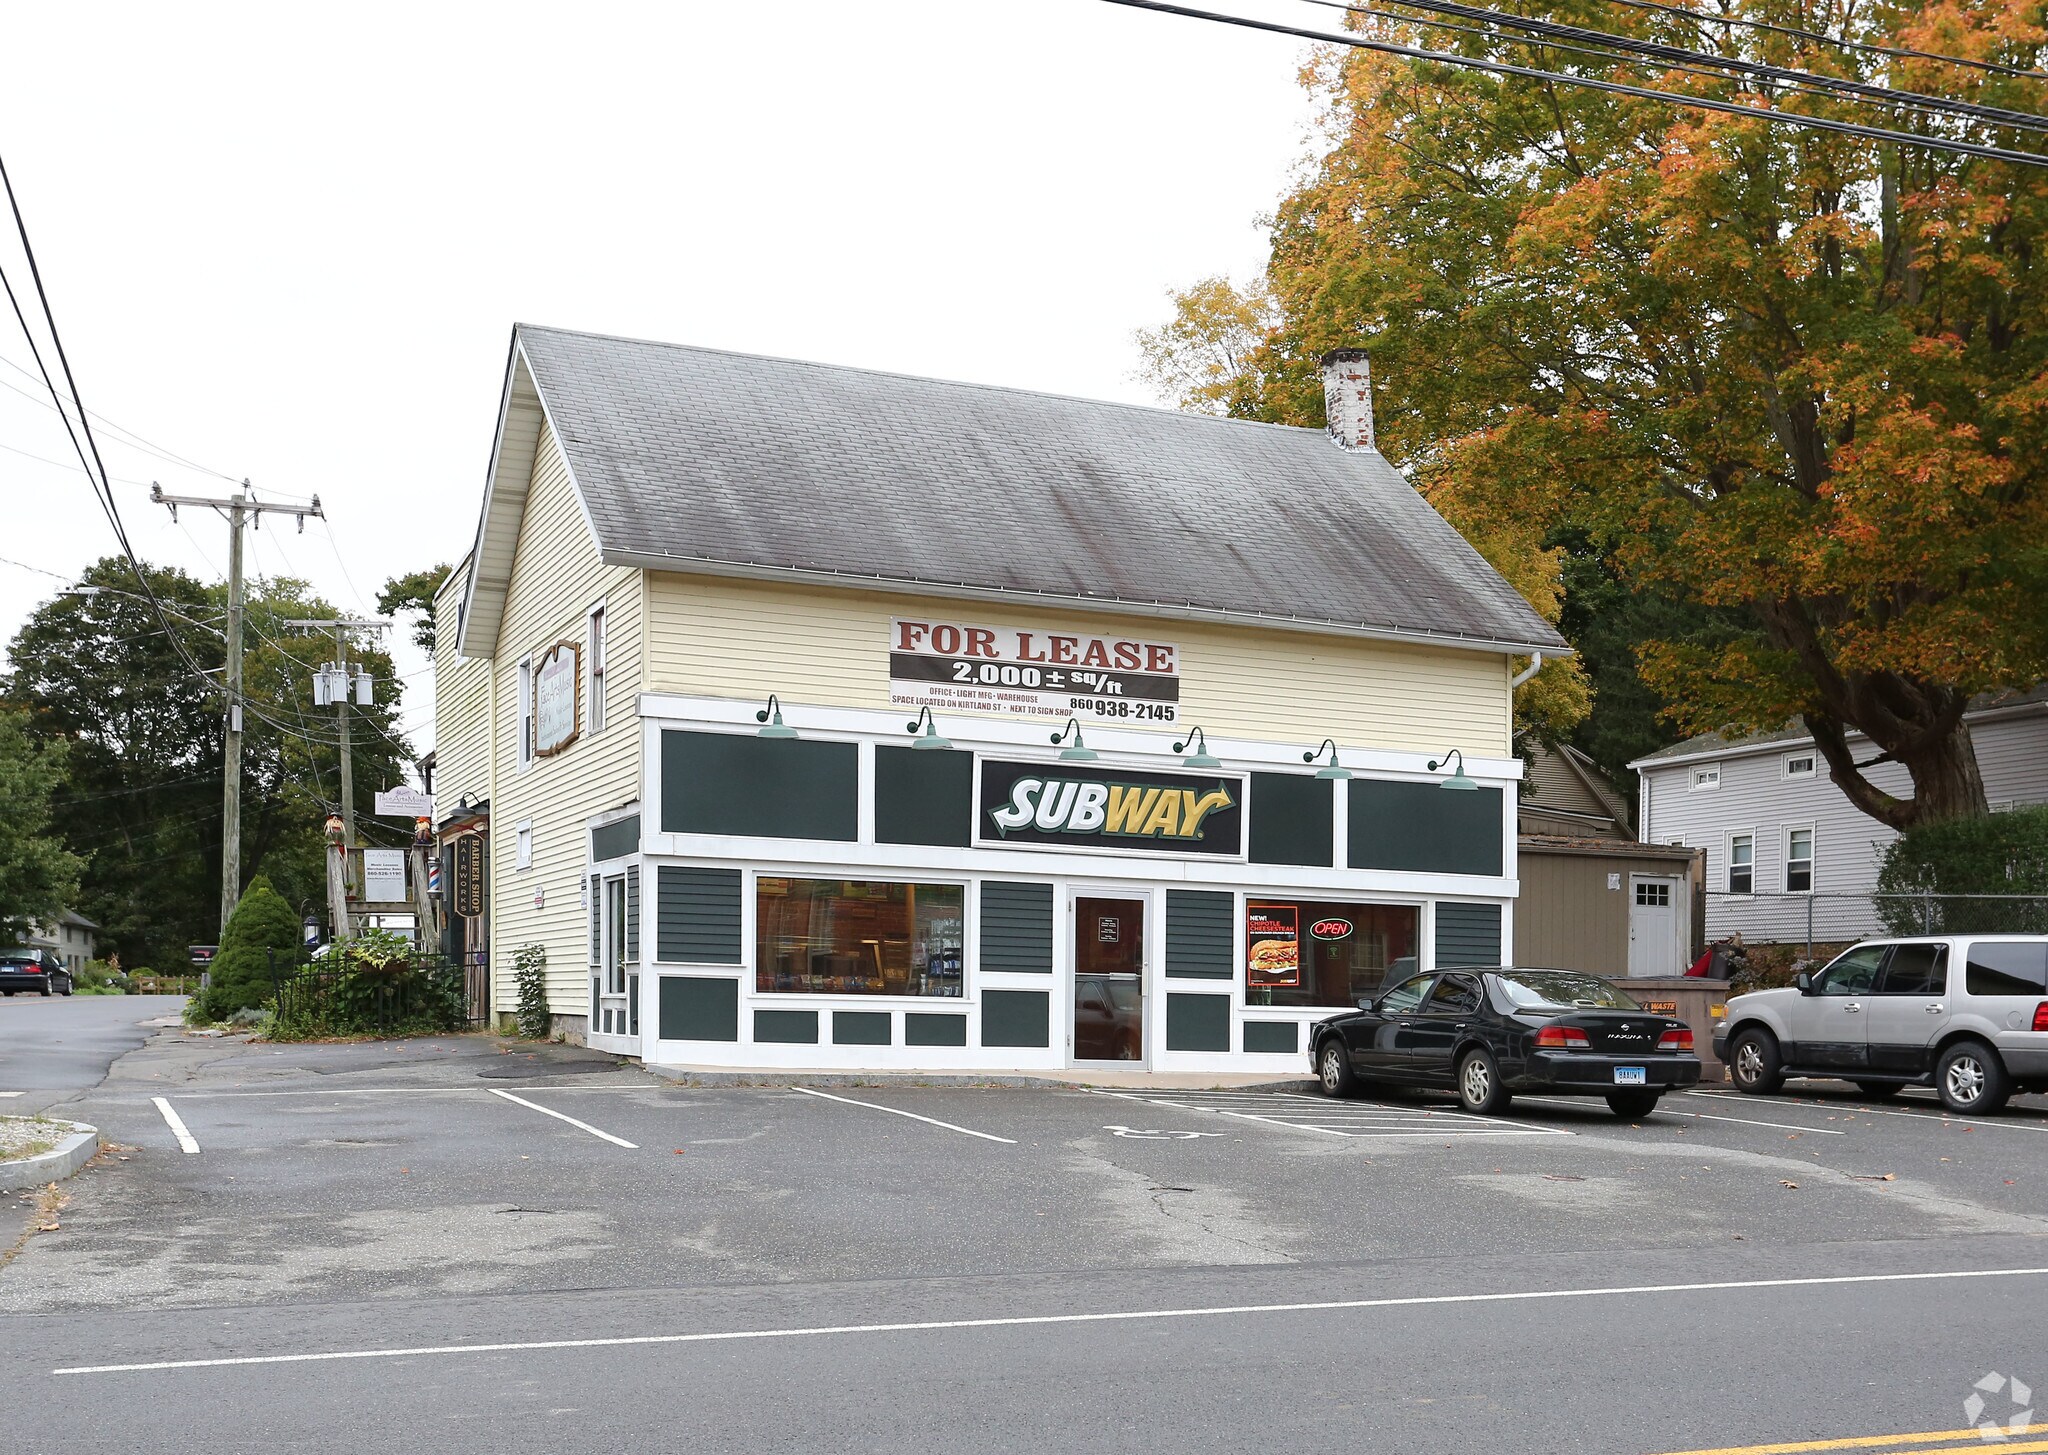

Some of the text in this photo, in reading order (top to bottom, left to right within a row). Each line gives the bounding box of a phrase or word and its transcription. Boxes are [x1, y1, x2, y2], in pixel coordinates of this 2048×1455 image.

[897, 621, 1173, 673] FOR LEASE
[952, 661, 1042, 688] 2,000
[1071, 671, 1122, 694] sq/ft
[892, 695, 1074, 717] SPACE LOCATED ON KIRTLAND ST NEXT TO SIGN SHOP
[929, 687, 1039, 704] OFFICE LIGHT MFG WAREHOUSE
[1070, 698, 1175, 721] 860 938-2145
[992, 778, 1234, 837] SUBWAY
[459, 839, 468, 912] HAIRWORKS
[471, 839, 480, 913] BARBER SHOP
[1314, 922, 1348, 935] OPEN
[1650, 1002, 1676, 1010] WASTE
[1618, 1071, 1641, 1080] 8AAUW1
